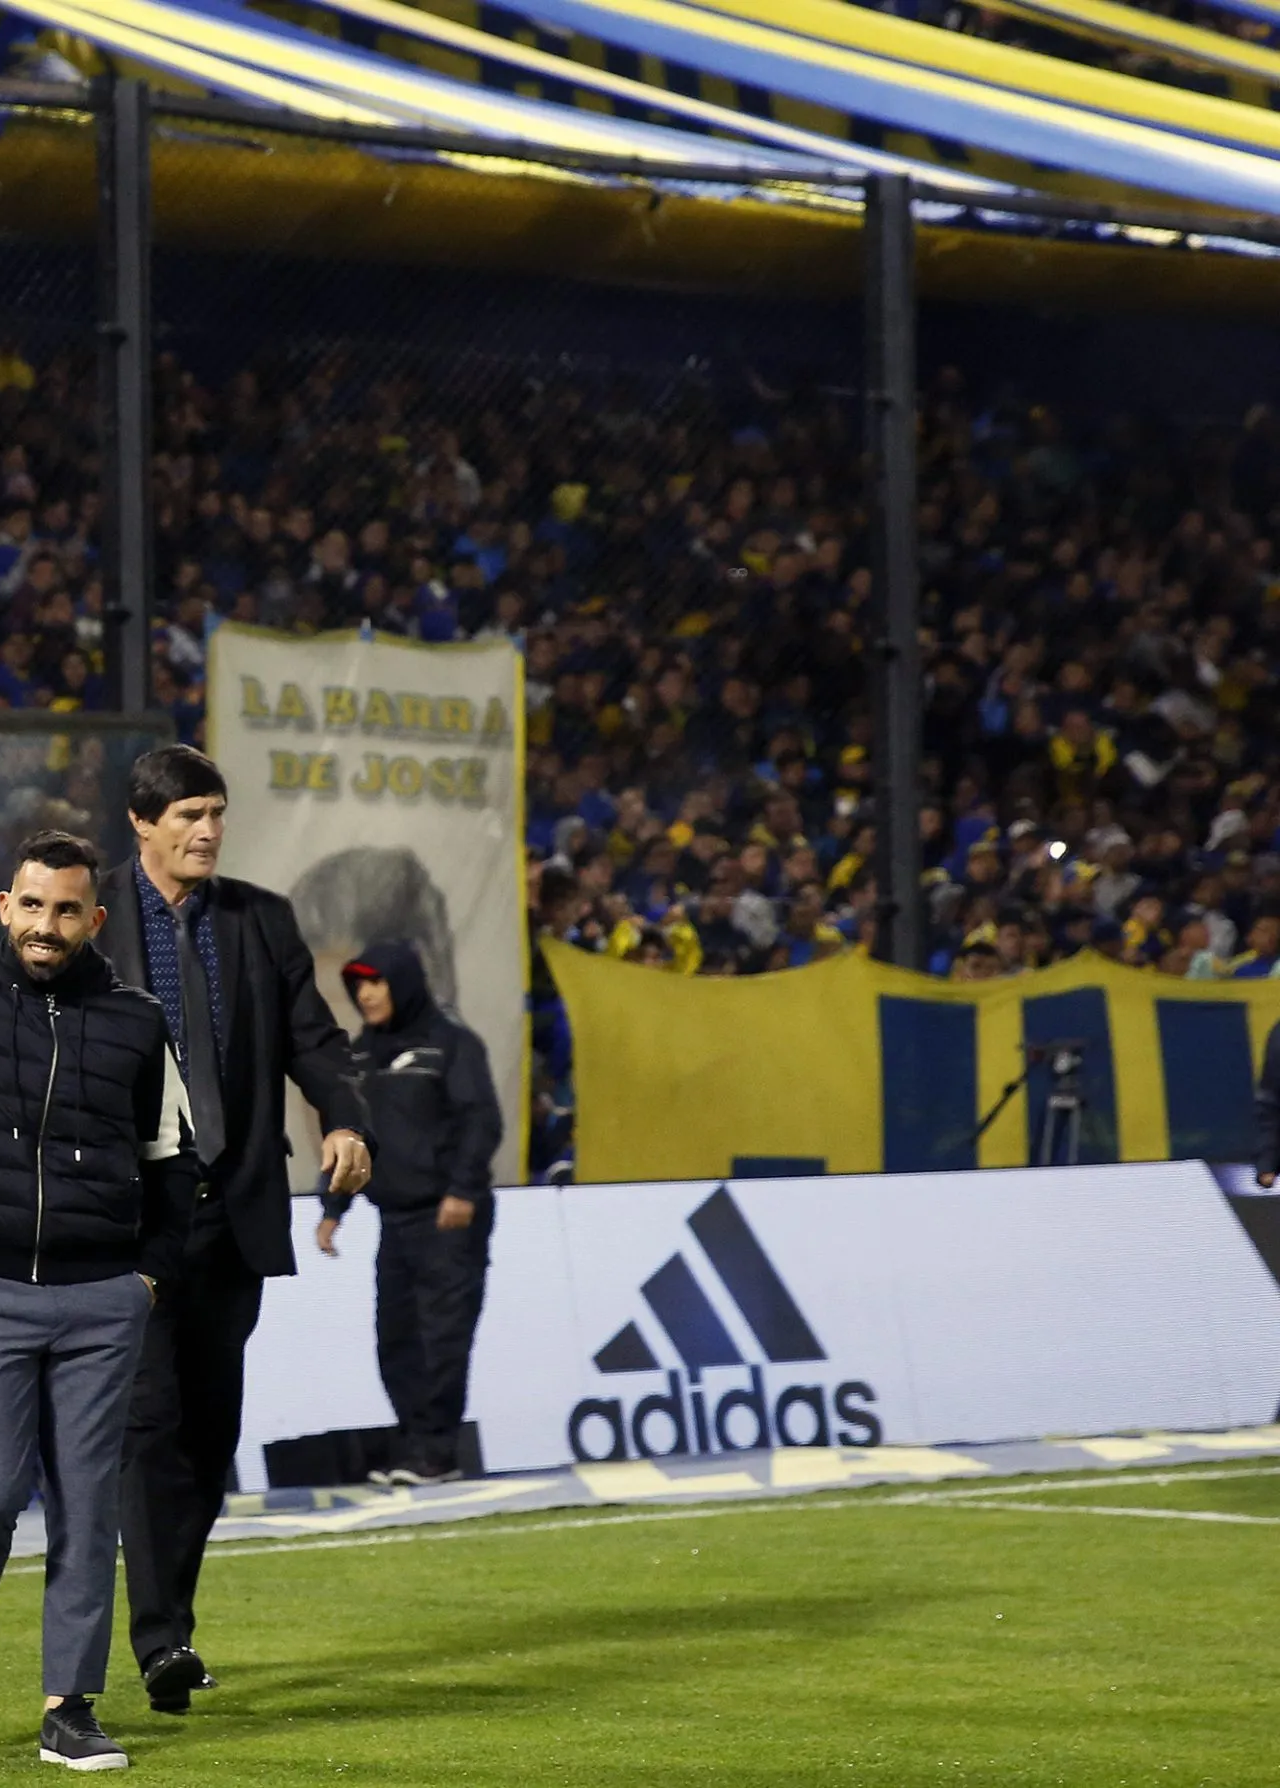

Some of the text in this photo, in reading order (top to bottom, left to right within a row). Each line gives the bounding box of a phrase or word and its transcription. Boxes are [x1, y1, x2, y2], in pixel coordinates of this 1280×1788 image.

[240, 674, 510, 744] LA BARRA
[269, 750, 488, 808] DE JOSE
[568, 1364, 882, 1463] adidas
